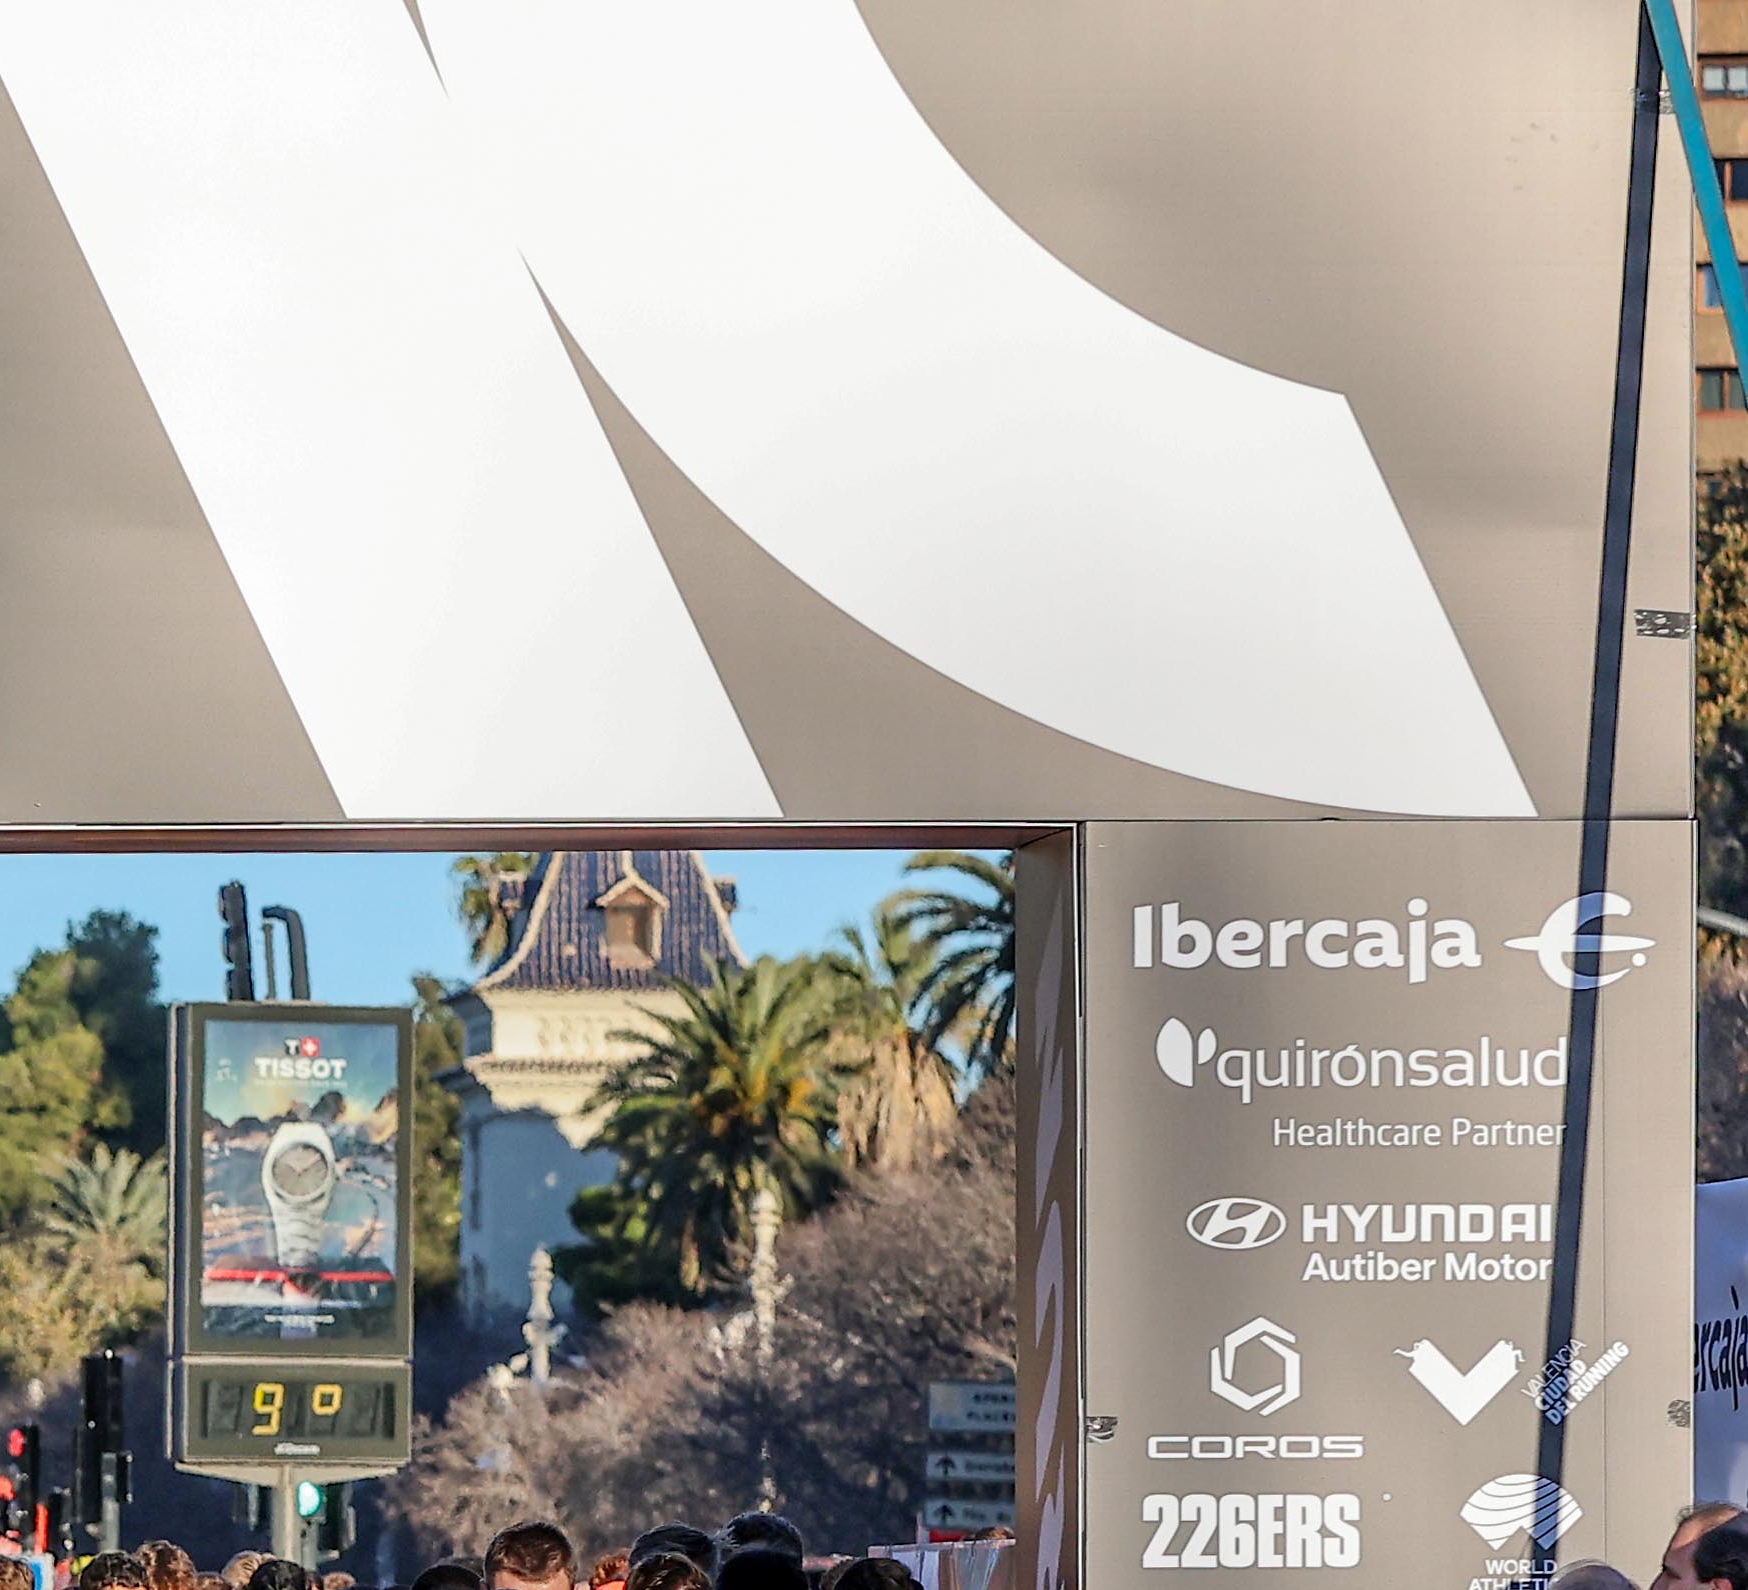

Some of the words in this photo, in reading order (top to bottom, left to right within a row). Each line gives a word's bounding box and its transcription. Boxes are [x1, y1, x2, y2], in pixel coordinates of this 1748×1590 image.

[1131, 897, 1483, 985] Ibercaja
[254, 1057, 347, 1080] TISSOT
[1215, 1036, 1568, 1104] quirónsalud
[1273, 1118, 1443, 1147] Healthcare
[1451, 1118, 1567, 1147] Partner
[1302, 1204, 1552, 1243] HYUNDAI
[1302, 1252, 1437, 1282] Autiber
[1444, 1252, 1553, 1282] Motor
[1521, 1338, 1588, 1399] VALENCIA
[1534, 1359, 1587, 1411] CIUDAD
[1545, 1396, 1578, 1425] DEL
[1568, 1341, 1629, 1402] RUNNING
[1146, 1435, 1365, 1460] COROS
[1141, 1493, 1362, 1569] 226ERS
[1485, 1559, 1558, 1575] WORLD
